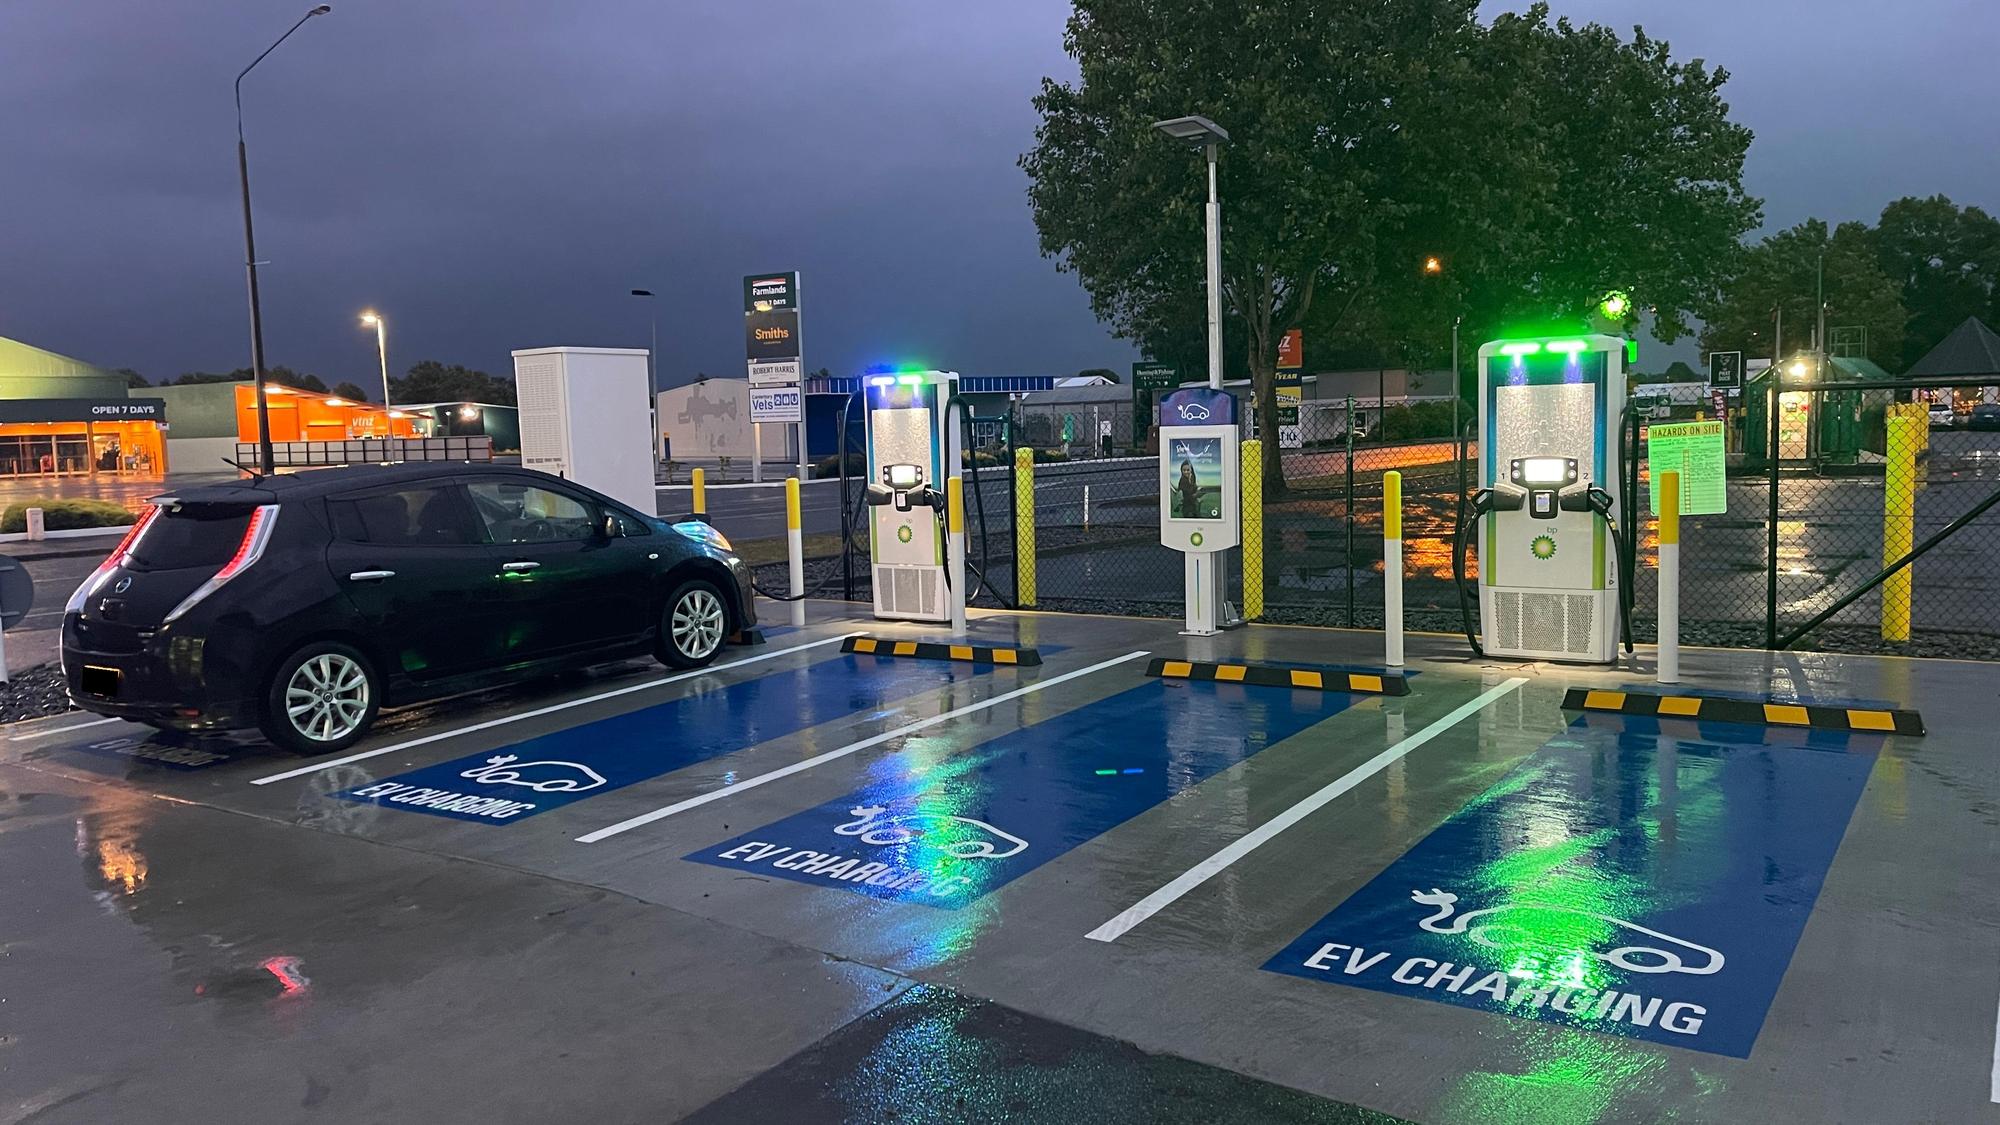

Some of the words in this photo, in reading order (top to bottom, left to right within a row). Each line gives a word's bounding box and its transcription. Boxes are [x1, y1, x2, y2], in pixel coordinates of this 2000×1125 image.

[752, 286, 787, 296] Farmlands
[755, 326, 789, 340] Smiths
[752, 366, 774, 375] ROBERT
[774, 365, 795, 373] HARRIS
[92, 406, 120, 414] OPEN
[122, 406, 128, 414] 7
[130, 406, 155, 414] DAYS
[752, 399, 773, 410] Vets
[1652, 427, 1687, 437] HAZARDS
[1690, 426, 1700, 435] ON
[1704, 424, 1720, 434] SITE
[1546, 526, 1558, 535] bp
[352, 782, 408, 798] EV
[389, 786, 536, 819] CHARGING
[718, 841, 792, 862] EV
[773, 850, 966, 897] CHARGING
[1303, 942, 1391, 975] EV
[1391, 956, 1707, 1036] CHARGING
